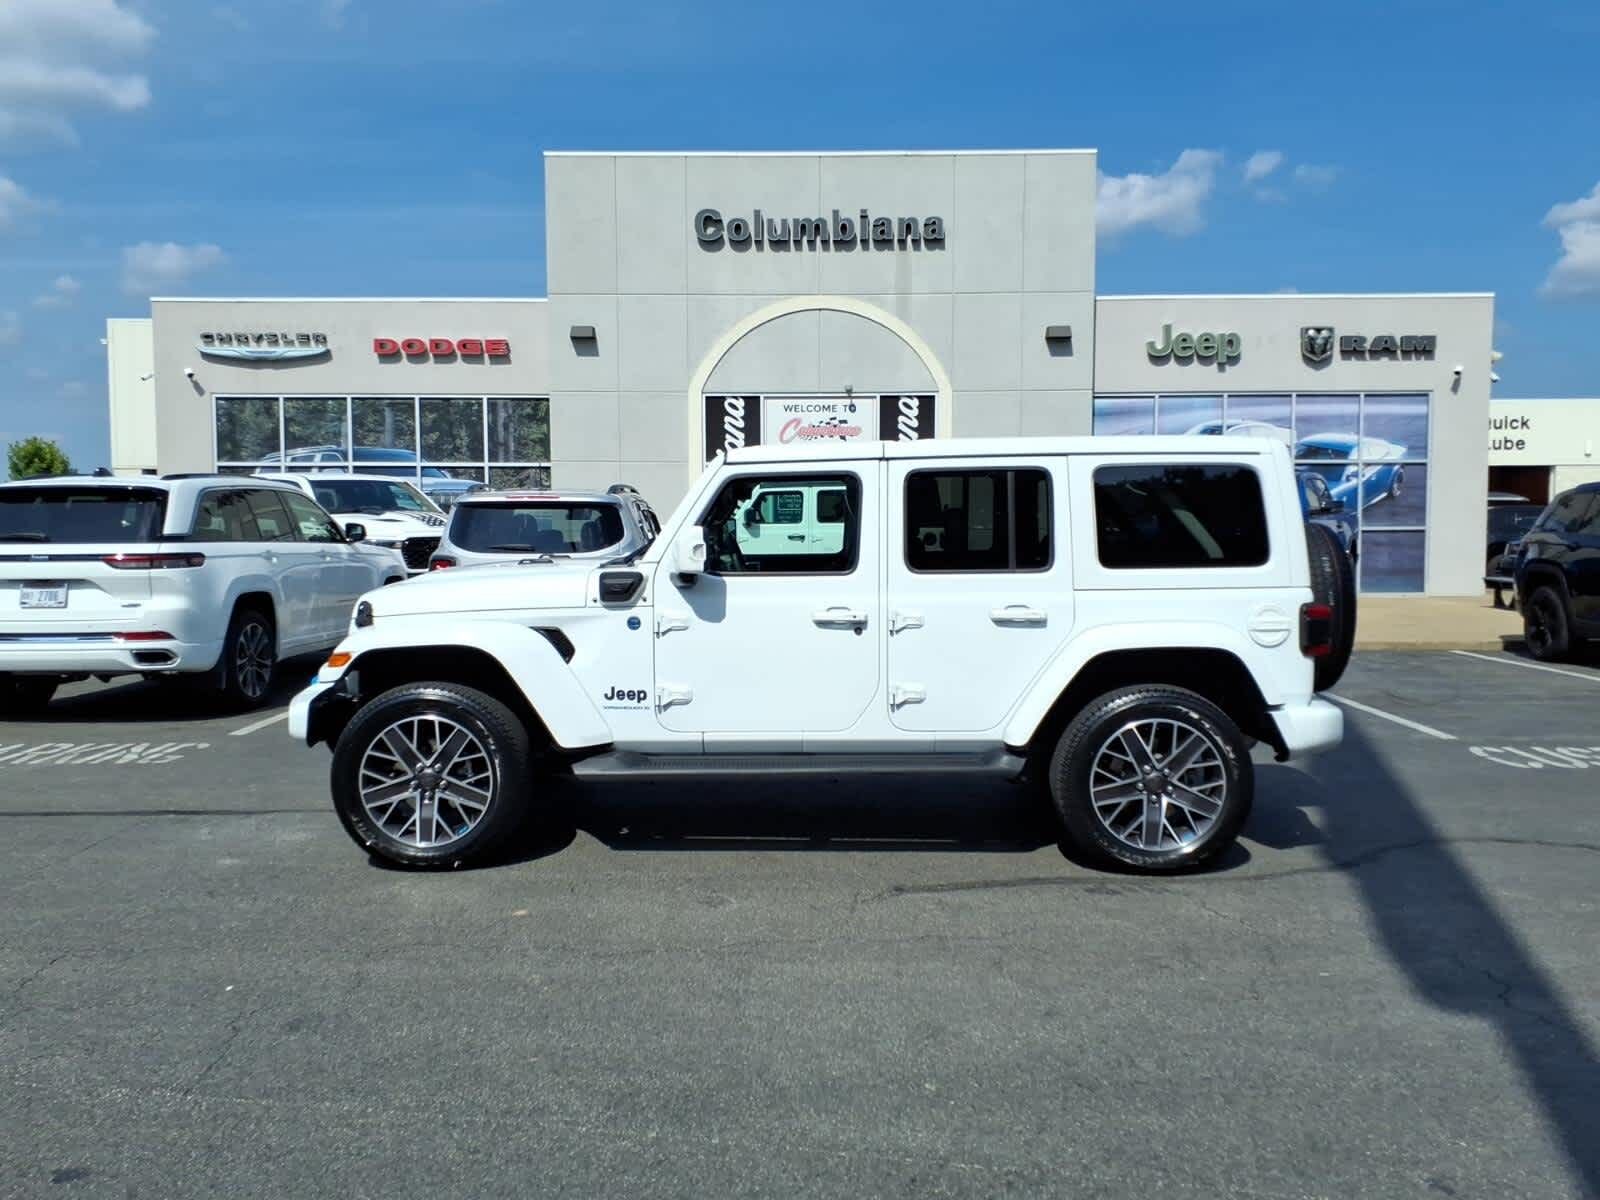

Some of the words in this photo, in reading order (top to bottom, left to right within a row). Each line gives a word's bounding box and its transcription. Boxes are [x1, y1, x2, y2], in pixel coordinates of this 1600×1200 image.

[694, 208, 945, 243] Columbiana
[199, 331, 328, 346] CHRYSLER
[373, 338, 510, 357] DODGE
[1145, 323, 1242, 364] Jeep
[1339, 335, 1437, 354] RAM
[783, 404, 837, 413] WELCOME
[843, 403, 857, 413] TO
[1488, 415, 1531, 430] uick
[1488, 436, 1526, 450] ube
[603, 685, 648, 704] Jeep
